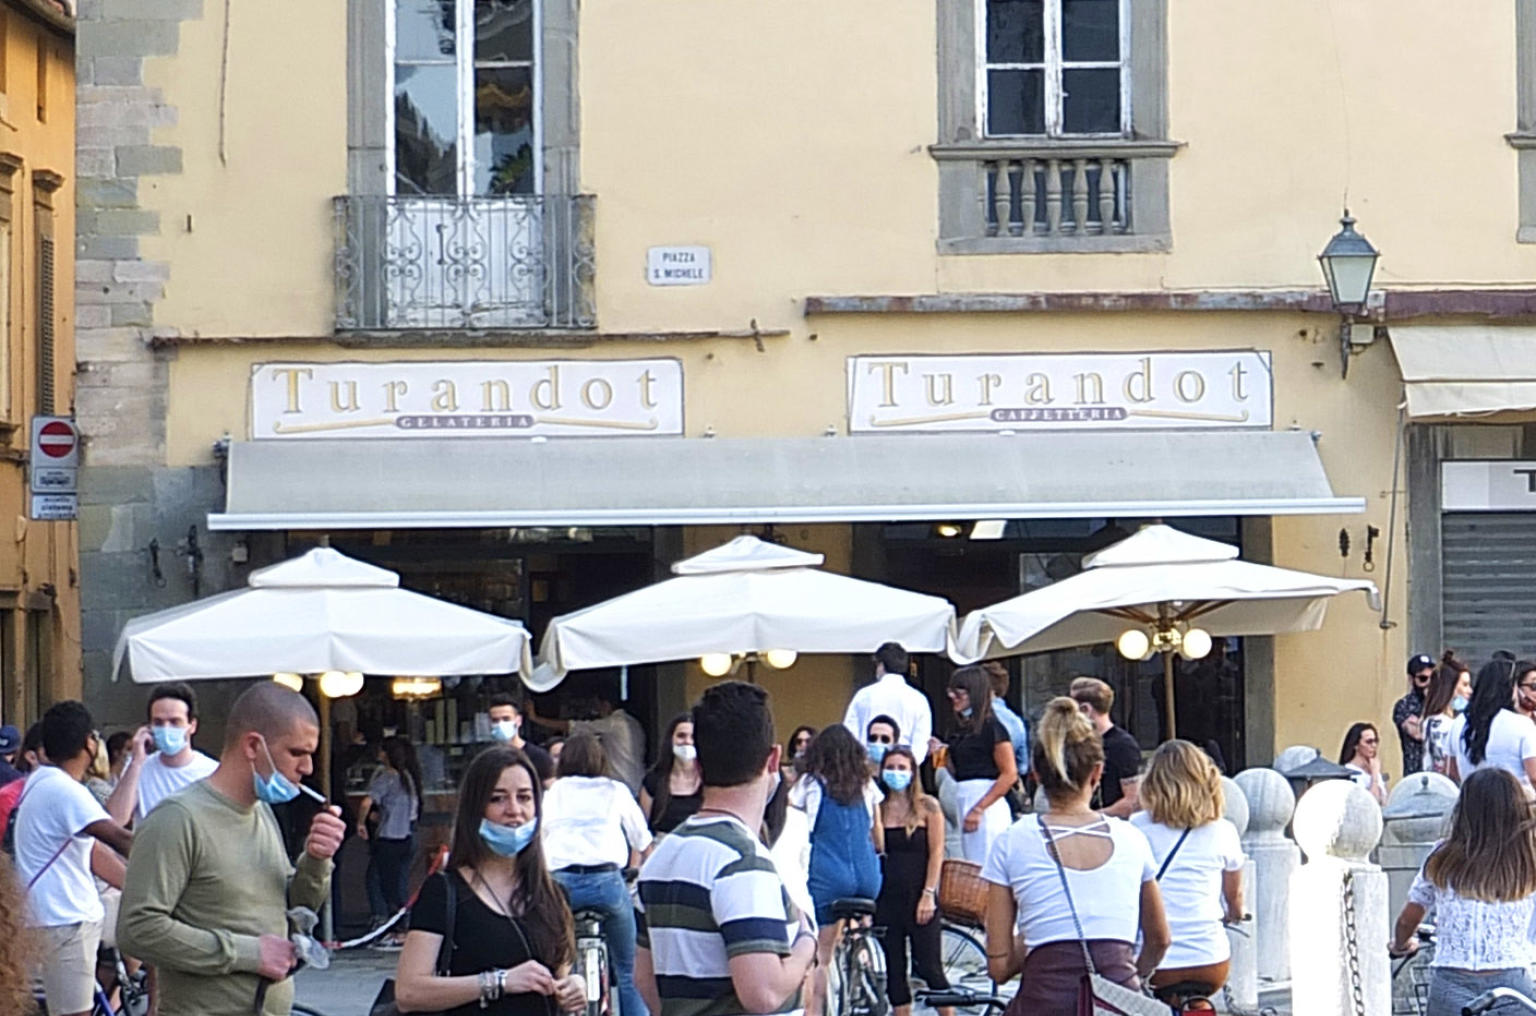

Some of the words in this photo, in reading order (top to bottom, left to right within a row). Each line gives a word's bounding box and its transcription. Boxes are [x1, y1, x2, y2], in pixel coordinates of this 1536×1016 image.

[662, 252, 696, 263] PIAZZA
[664, 268, 704, 279] MICHELE
[868, 357, 1250, 408] Turandot
[272, 364, 659, 415] Turandot
[994, 408, 1123, 421] CAFFETTERIA
[400, 415, 529, 428] GELATERIA
